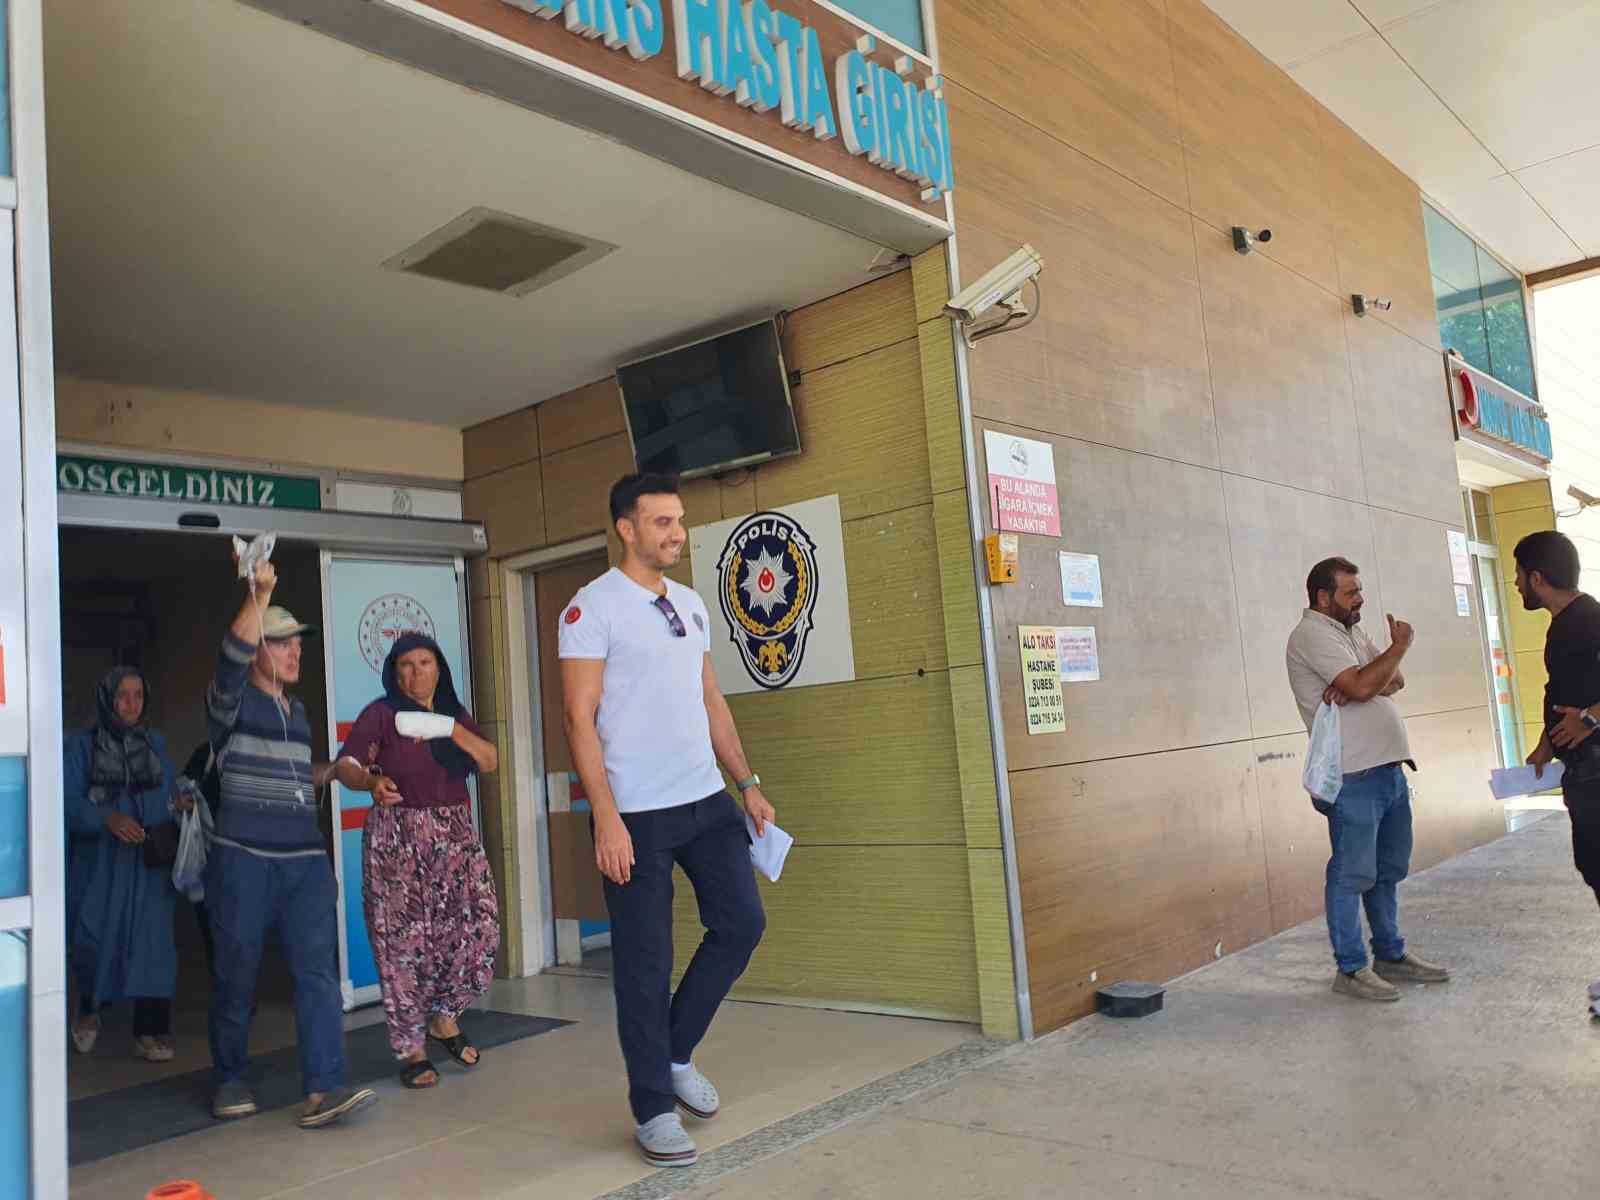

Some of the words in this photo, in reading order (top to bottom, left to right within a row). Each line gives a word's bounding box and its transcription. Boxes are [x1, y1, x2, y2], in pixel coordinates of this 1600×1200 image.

[675, 0, 837, 141] HASTA
[836, 34, 954, 202] GİRİŞİ
[738, 519, 790, 550] POLİS
[1023, 634, 1036, 650] ALO
[1037, 633, 1056, 651] TAKSİ
[1026, 659, 1056, 673] HASTANE
